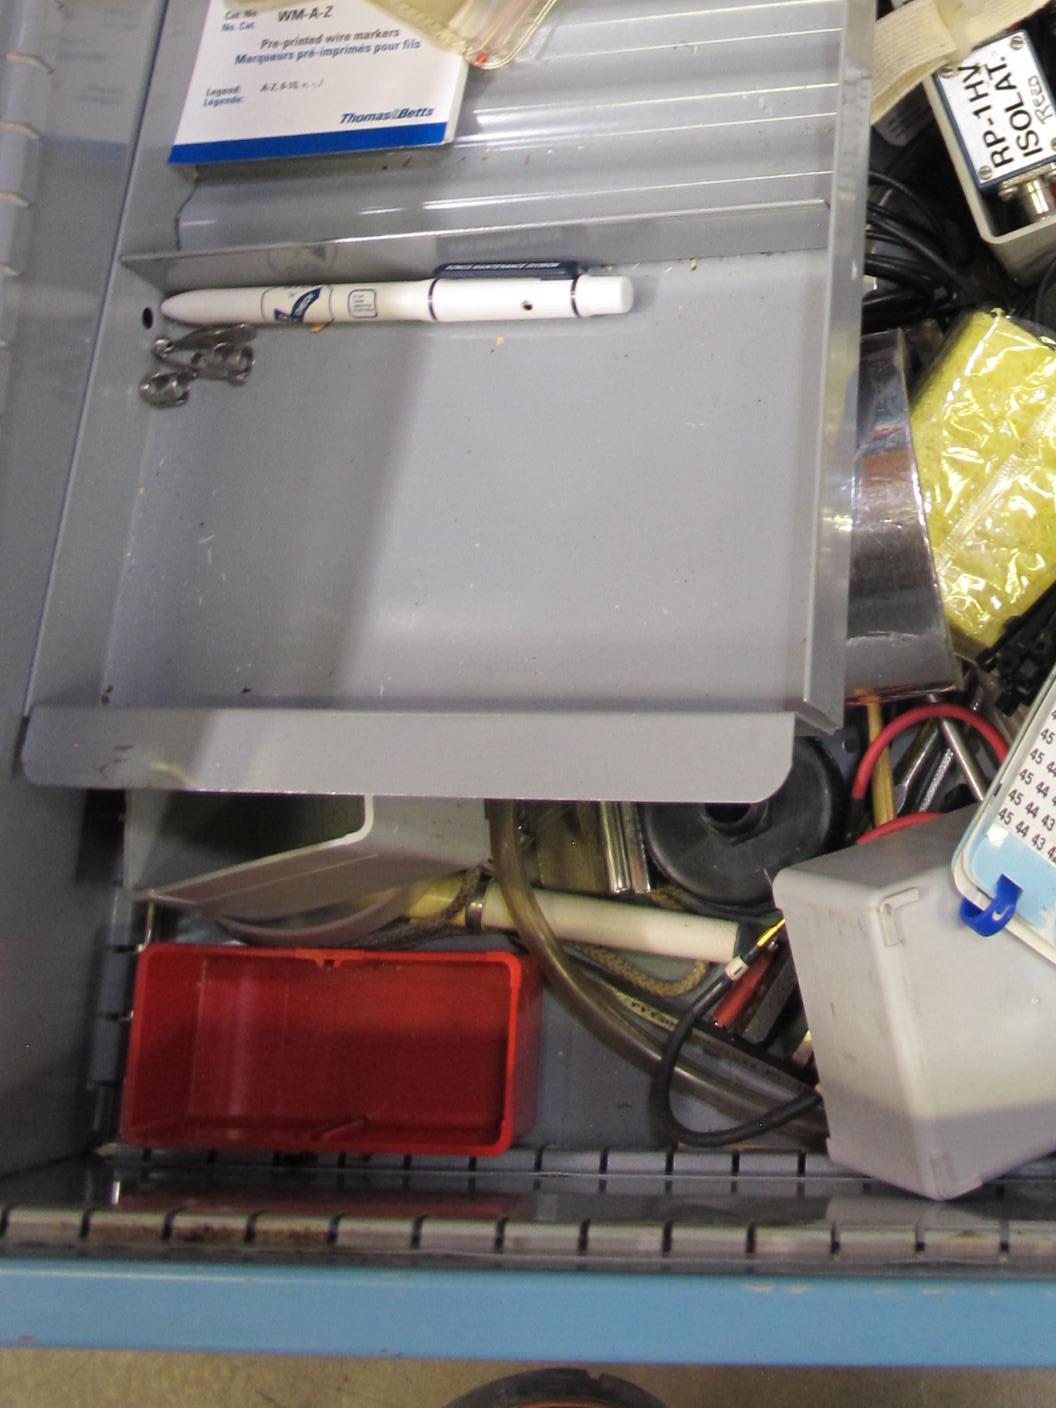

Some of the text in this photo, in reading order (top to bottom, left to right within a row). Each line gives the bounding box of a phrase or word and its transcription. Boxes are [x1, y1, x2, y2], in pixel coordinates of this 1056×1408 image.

[277, 4, 335, 22] WM-A-Z
[260, 28, 400, 50] Pre-printed wire markers
[234, 50, 295, 66] Marqueurs
[373, 40, 401, 55] pour
[402, 38, 421, 50] fils
[982, 55, 1043, 158] ISOLAT.
[1028, 747, 1045, 765] 45
[996, 806, 1014, 826] 45
[1014, 819, 1030, 838] 44
[1030, 832, 1046, 851] 43
